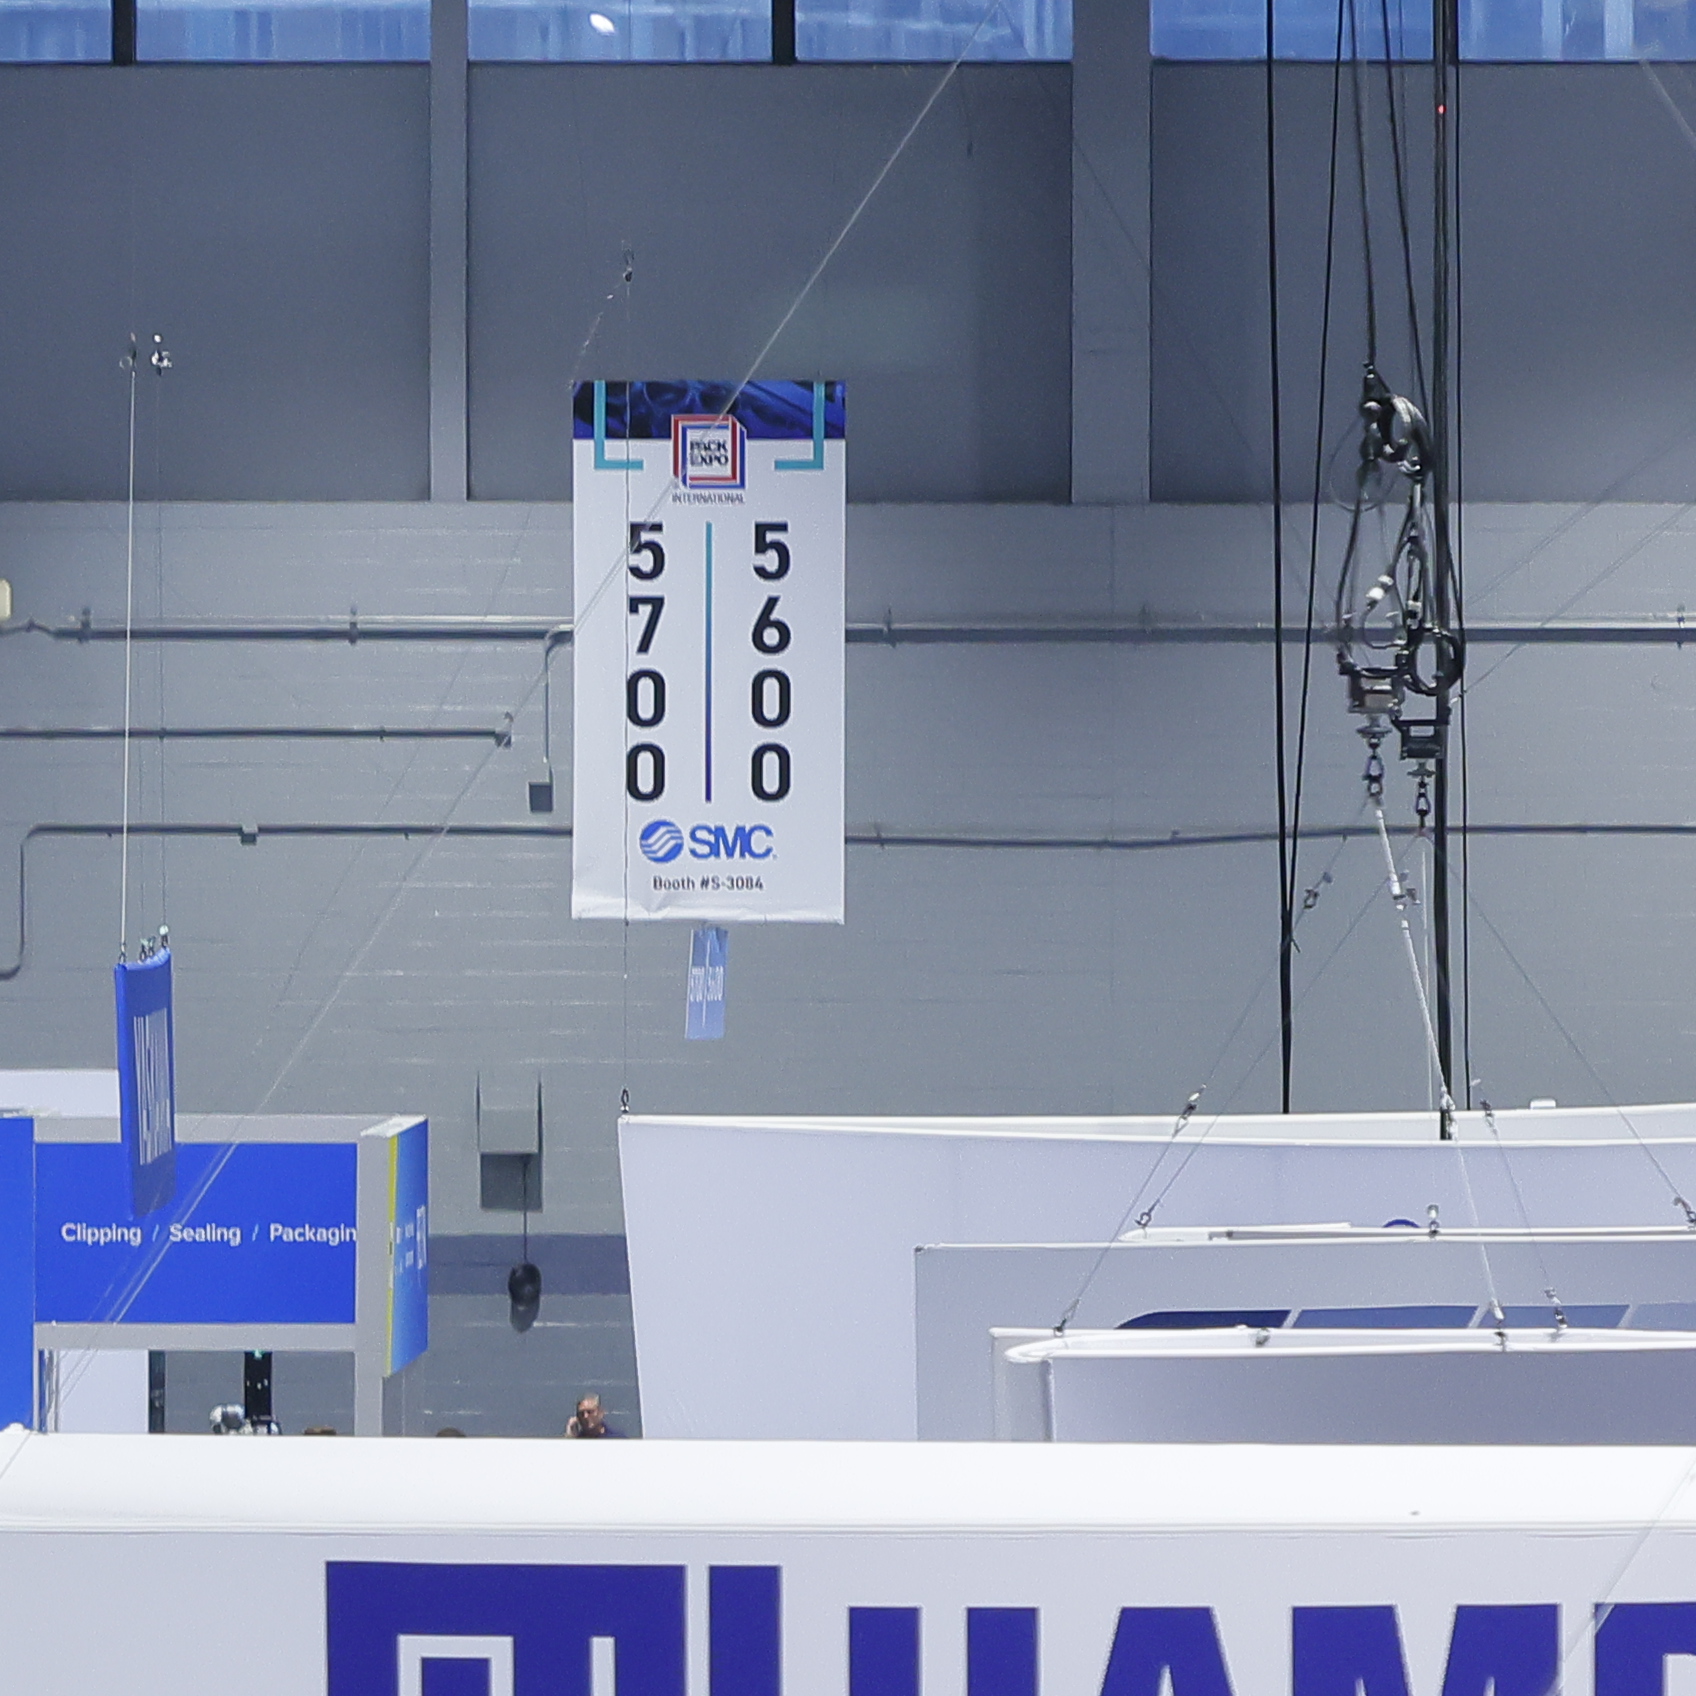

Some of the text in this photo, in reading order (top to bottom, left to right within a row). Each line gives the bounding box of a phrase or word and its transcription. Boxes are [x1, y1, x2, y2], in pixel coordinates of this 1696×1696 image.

[690, 440, 728, 451] PACK
[688, 824, 774, 860] SMC
[653, 875, 695, 891] Booth
[61, 1222, 143, 1247] Clipping
[169, 1222, 242, 1247] Sealing
[269, 1222, 356, 1247] Packagin
